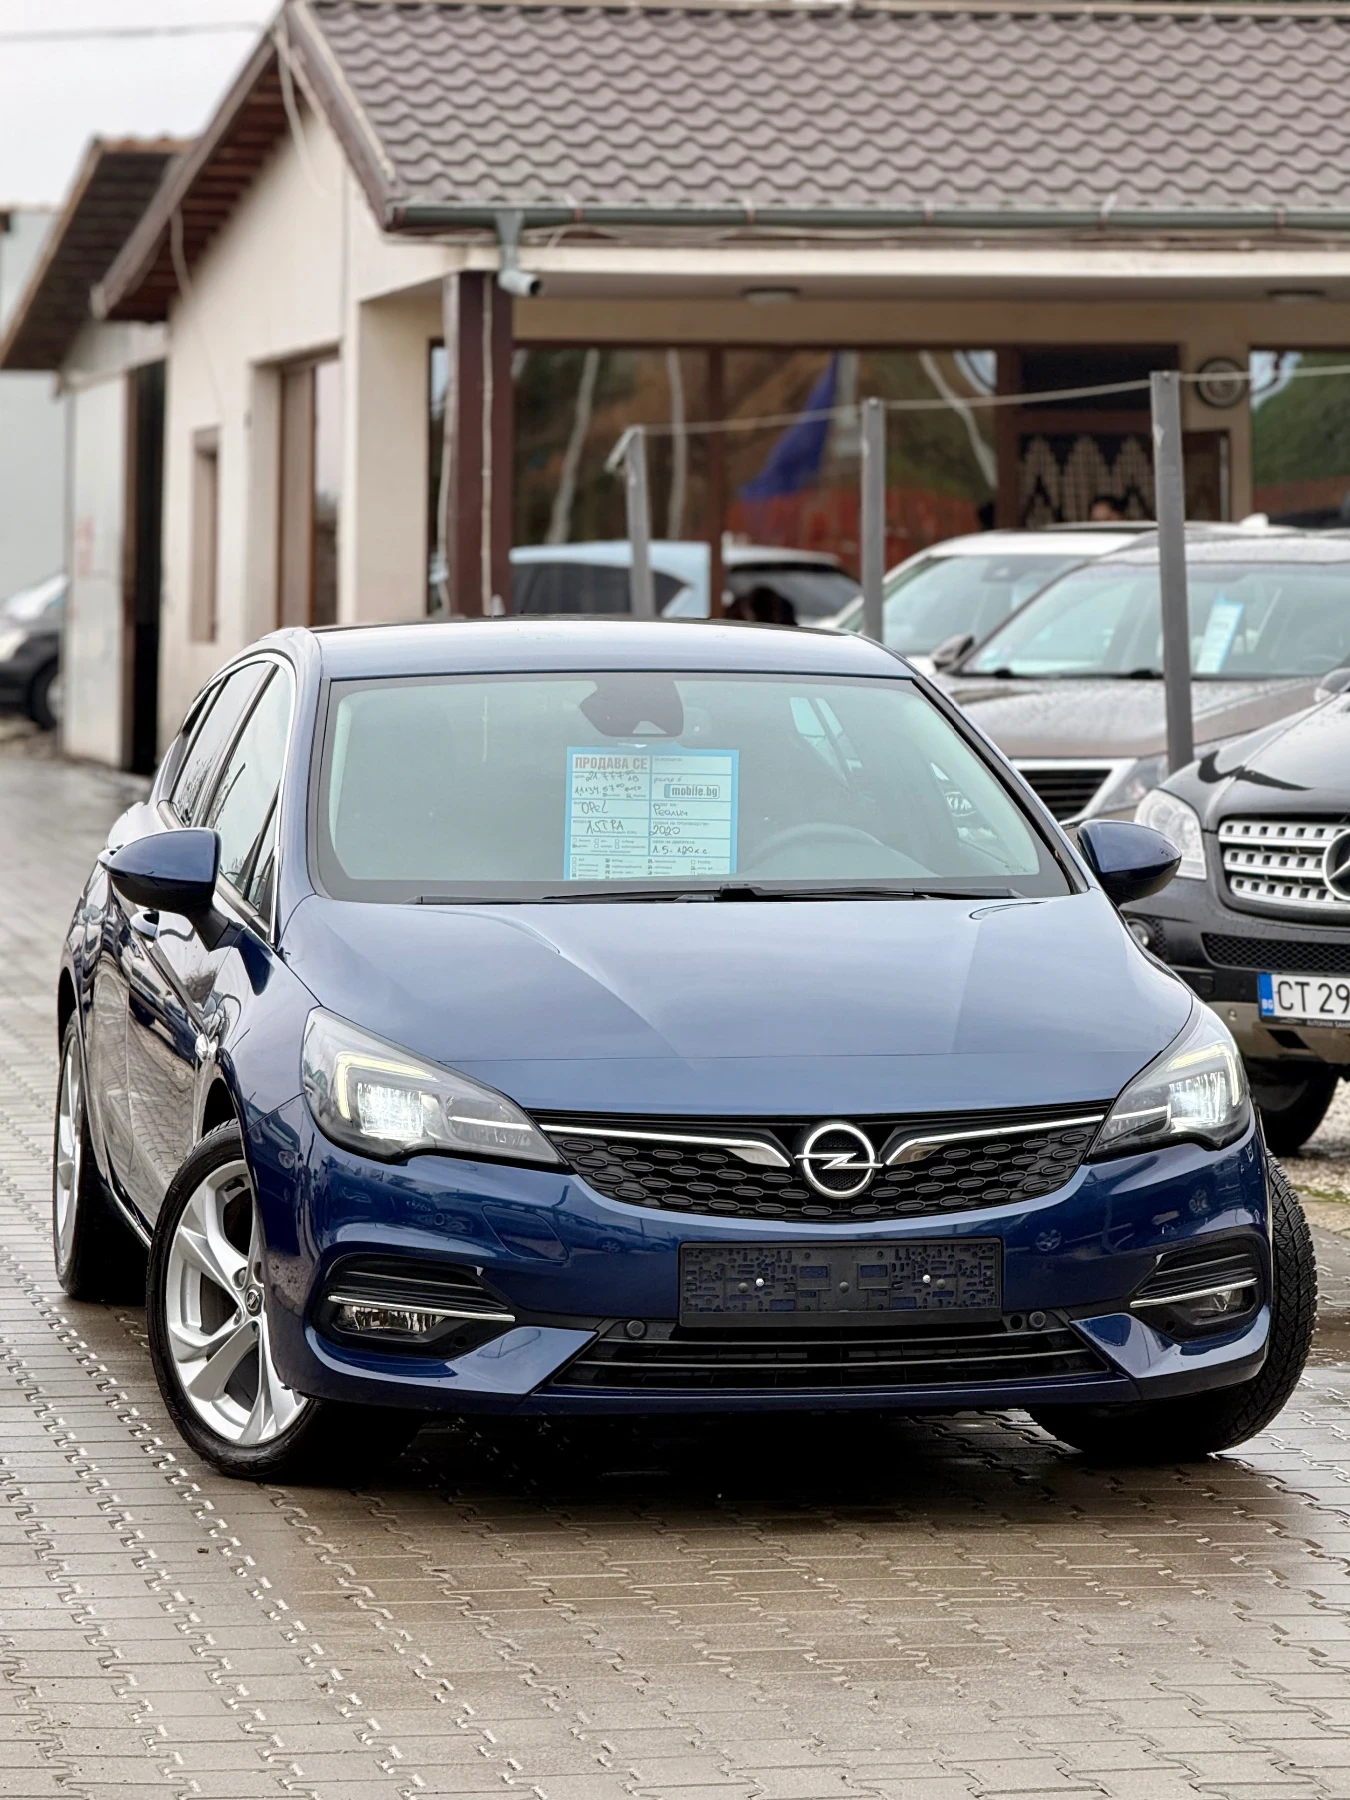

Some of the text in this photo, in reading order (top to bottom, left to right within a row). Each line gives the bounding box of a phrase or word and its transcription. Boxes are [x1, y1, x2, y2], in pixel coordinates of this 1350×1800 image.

[575, 757, 648, 770] ПРОДАВА СЕ
[672, 786, 718, 798] mobile.bg
[586, 819, 624, 834] ASTRA
[649, 825, 680, 836] 2020
[1277, 981, 1310, 1012] CT
